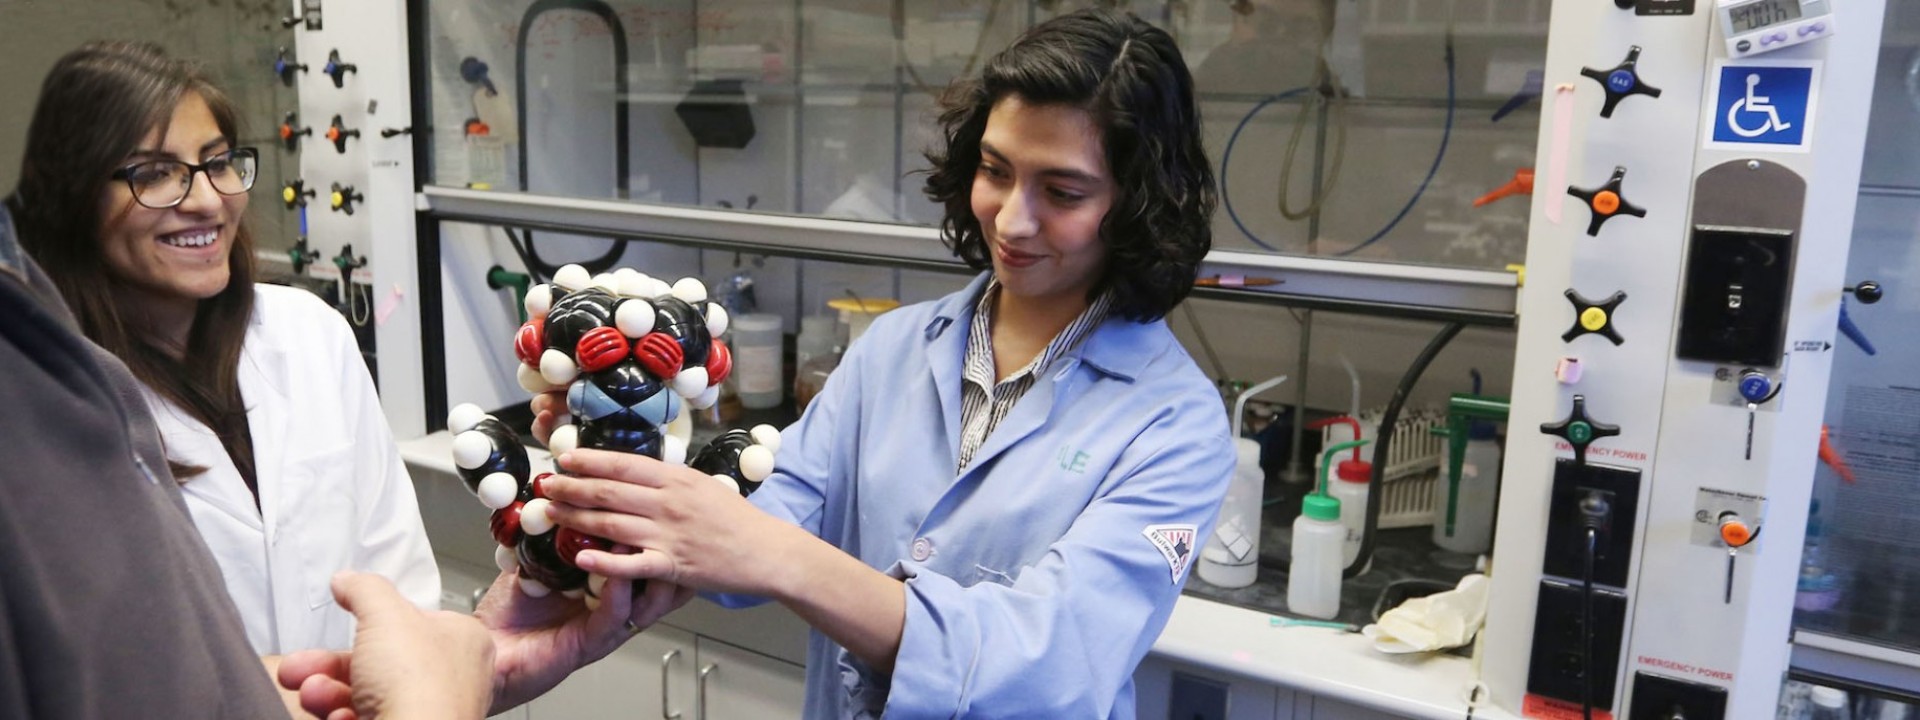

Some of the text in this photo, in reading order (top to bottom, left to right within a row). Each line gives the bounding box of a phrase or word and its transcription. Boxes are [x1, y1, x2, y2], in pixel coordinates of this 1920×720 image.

[1612, 448, 1648, 461] POWER
[1637, 655, 1734, 682] EMERGENCY POWER
